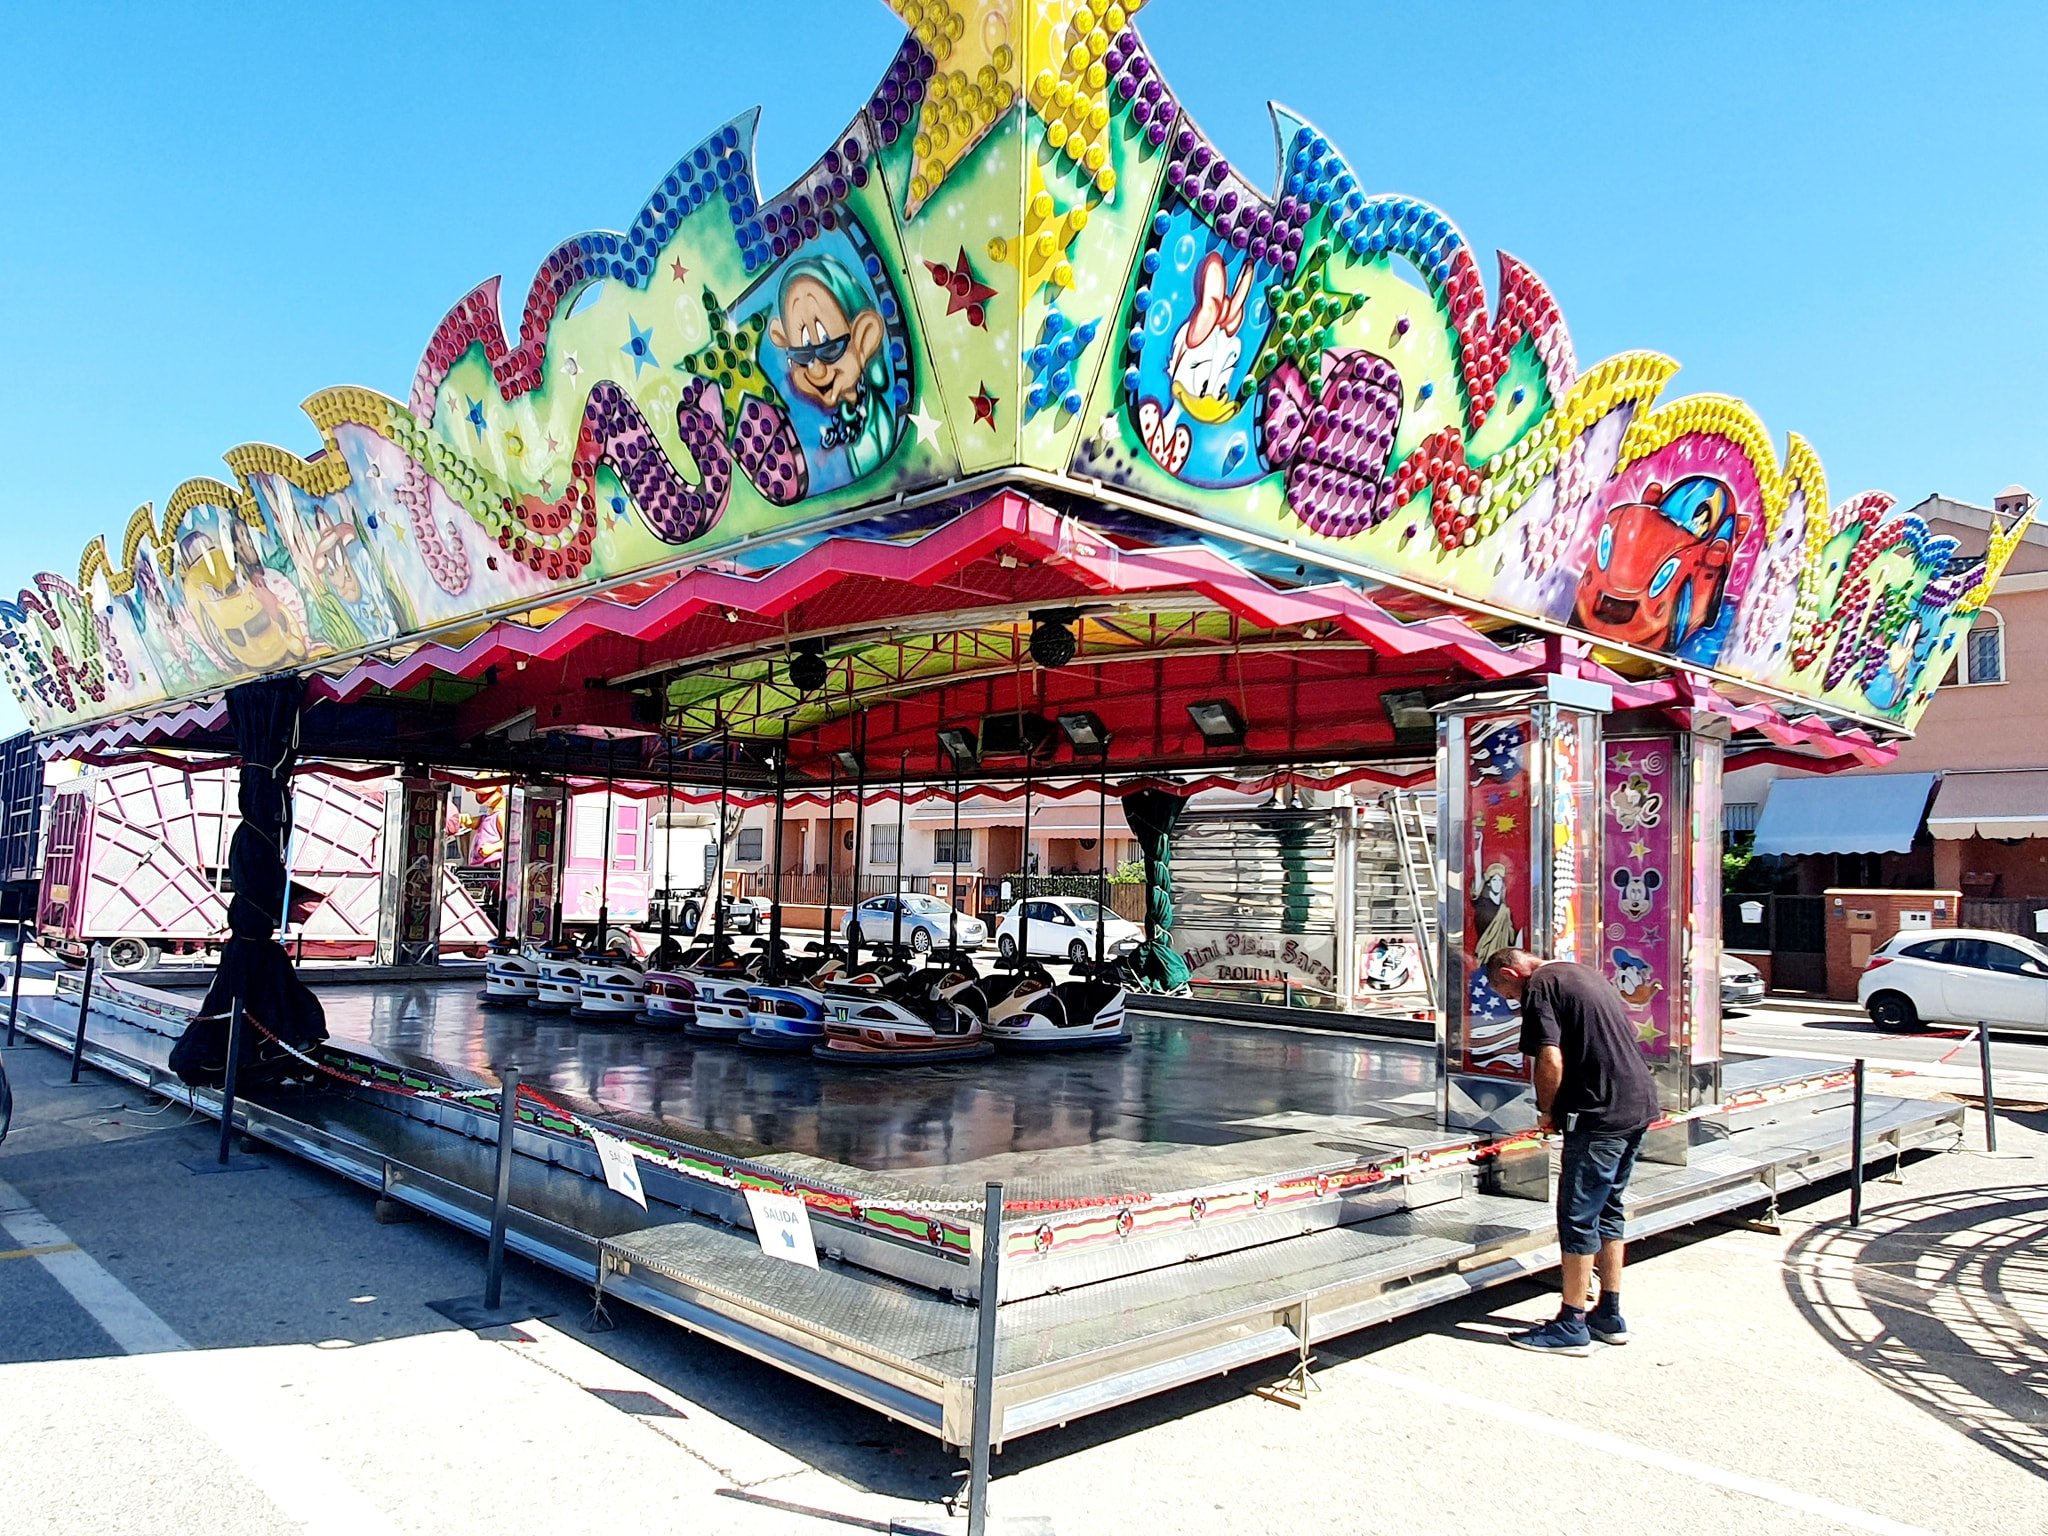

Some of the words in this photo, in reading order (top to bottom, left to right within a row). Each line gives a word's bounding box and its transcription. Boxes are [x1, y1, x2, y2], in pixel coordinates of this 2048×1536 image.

[414, 797, 434, 850] MINI
[535, 805, 553, 858] MINI
[1281, 939, 1332, 987] Sara
[654, 983, 661, 994] 7
[763, 1000, 772, 1013] 11
[837, 1008, 847, 1022] 14
[763, 1206, 799, 1225] SALIDA
